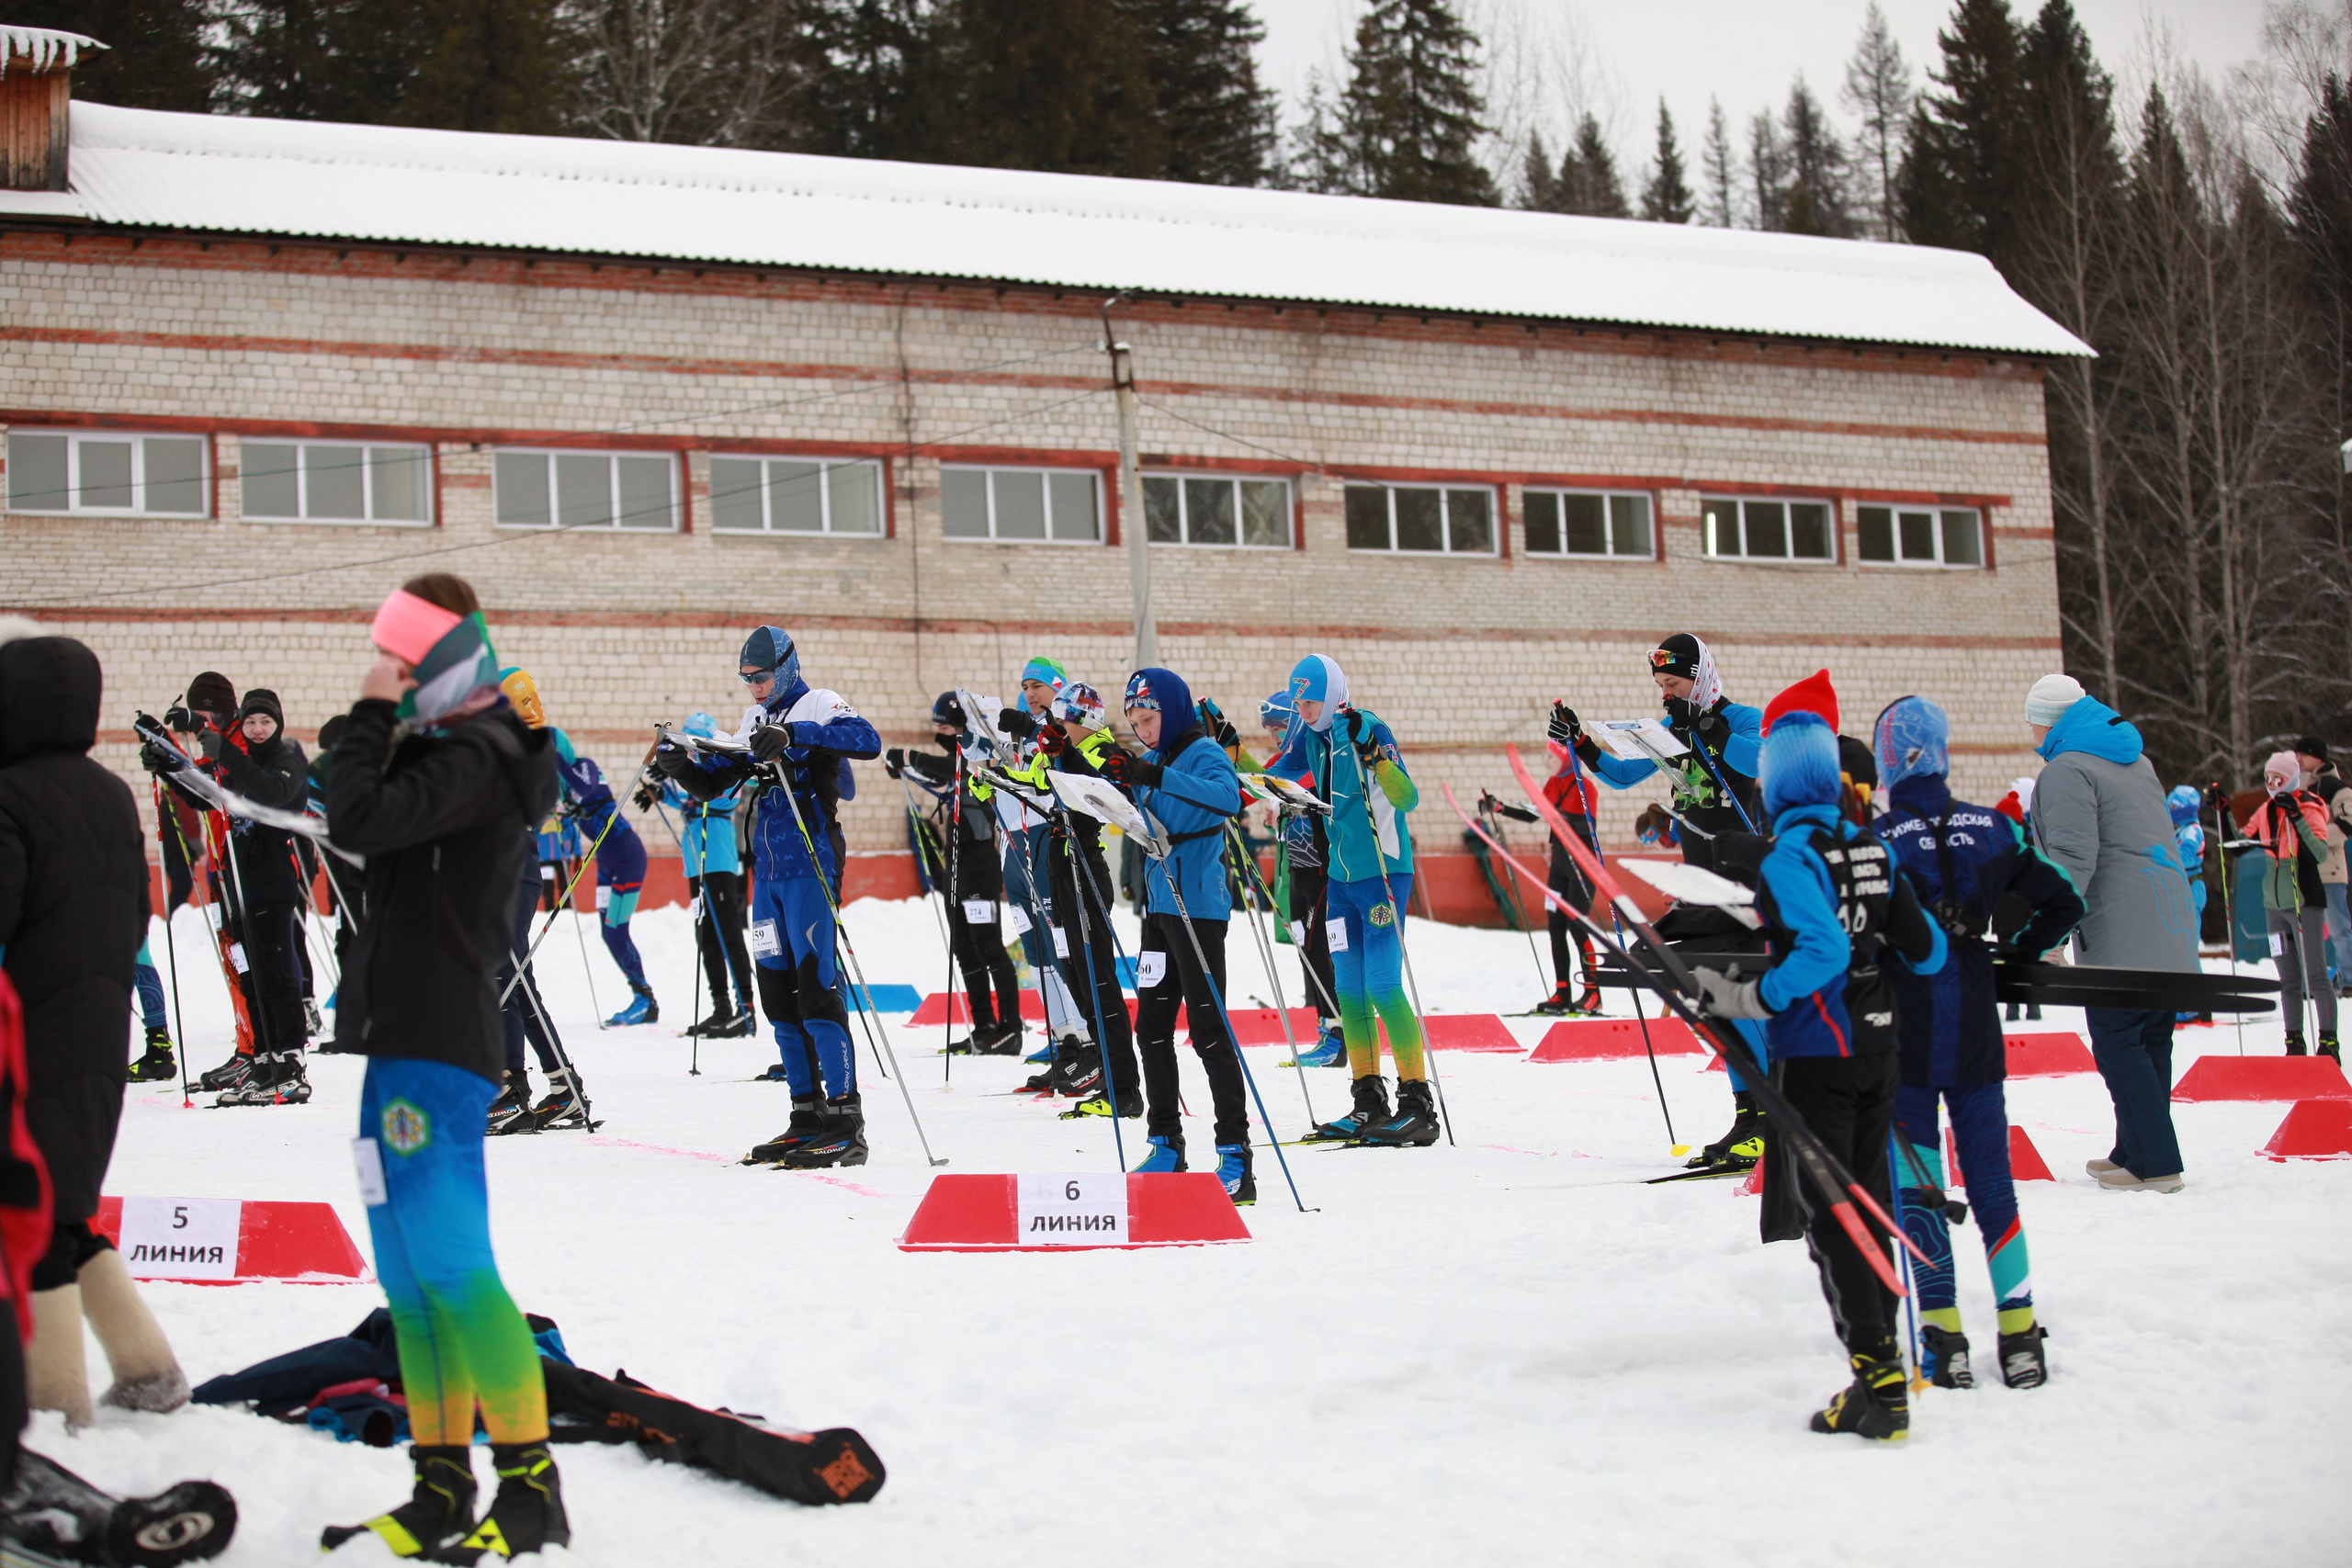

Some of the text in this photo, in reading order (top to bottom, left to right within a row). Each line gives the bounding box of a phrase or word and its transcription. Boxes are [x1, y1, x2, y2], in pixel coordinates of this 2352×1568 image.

[1881, 813, 1994, 839] НИЖЕДСКАЯ
[1918, 832, 1974, 850] ОБСТЬ
[753, 930, 764, 942] 59
[1070, 1066, 1101, 1088] SPINE
[1066, 1180, 1080, 1201] 6
[173, 1206, 188, 1229] 5
[1030, 1215, 1115, 1232] линия
[130, 1245, 223, 1264] линия
